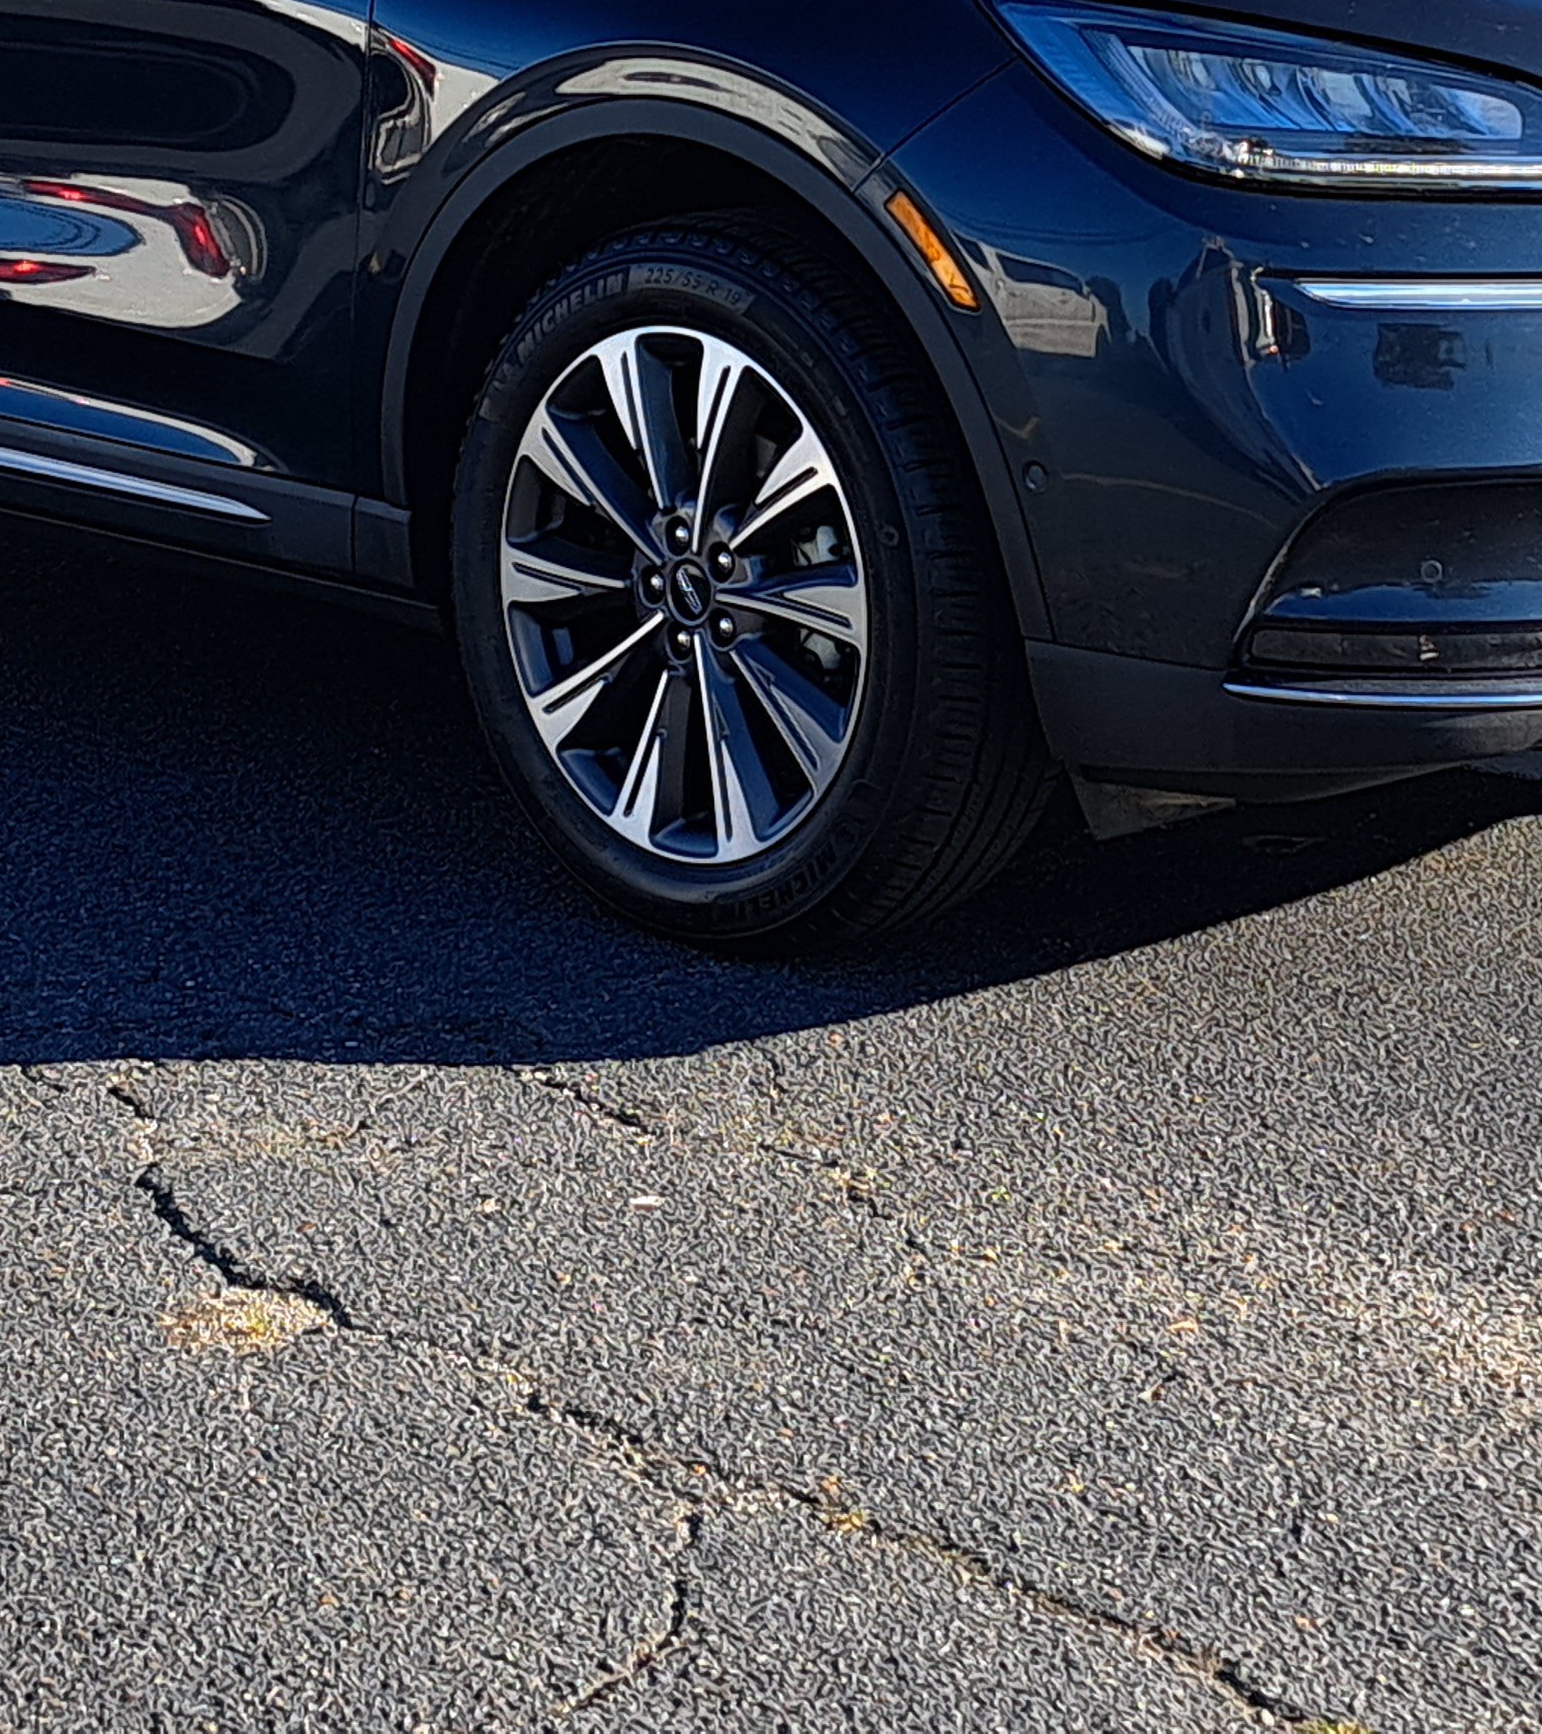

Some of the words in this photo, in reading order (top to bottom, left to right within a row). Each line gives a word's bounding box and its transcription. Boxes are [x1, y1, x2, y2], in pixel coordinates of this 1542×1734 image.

[516, 270, 626, 364] MICHELIN
[643, 267, 701, 292] 225/55
[705, 278, 721, 295] R
[725, 287, 743, 307] 19
